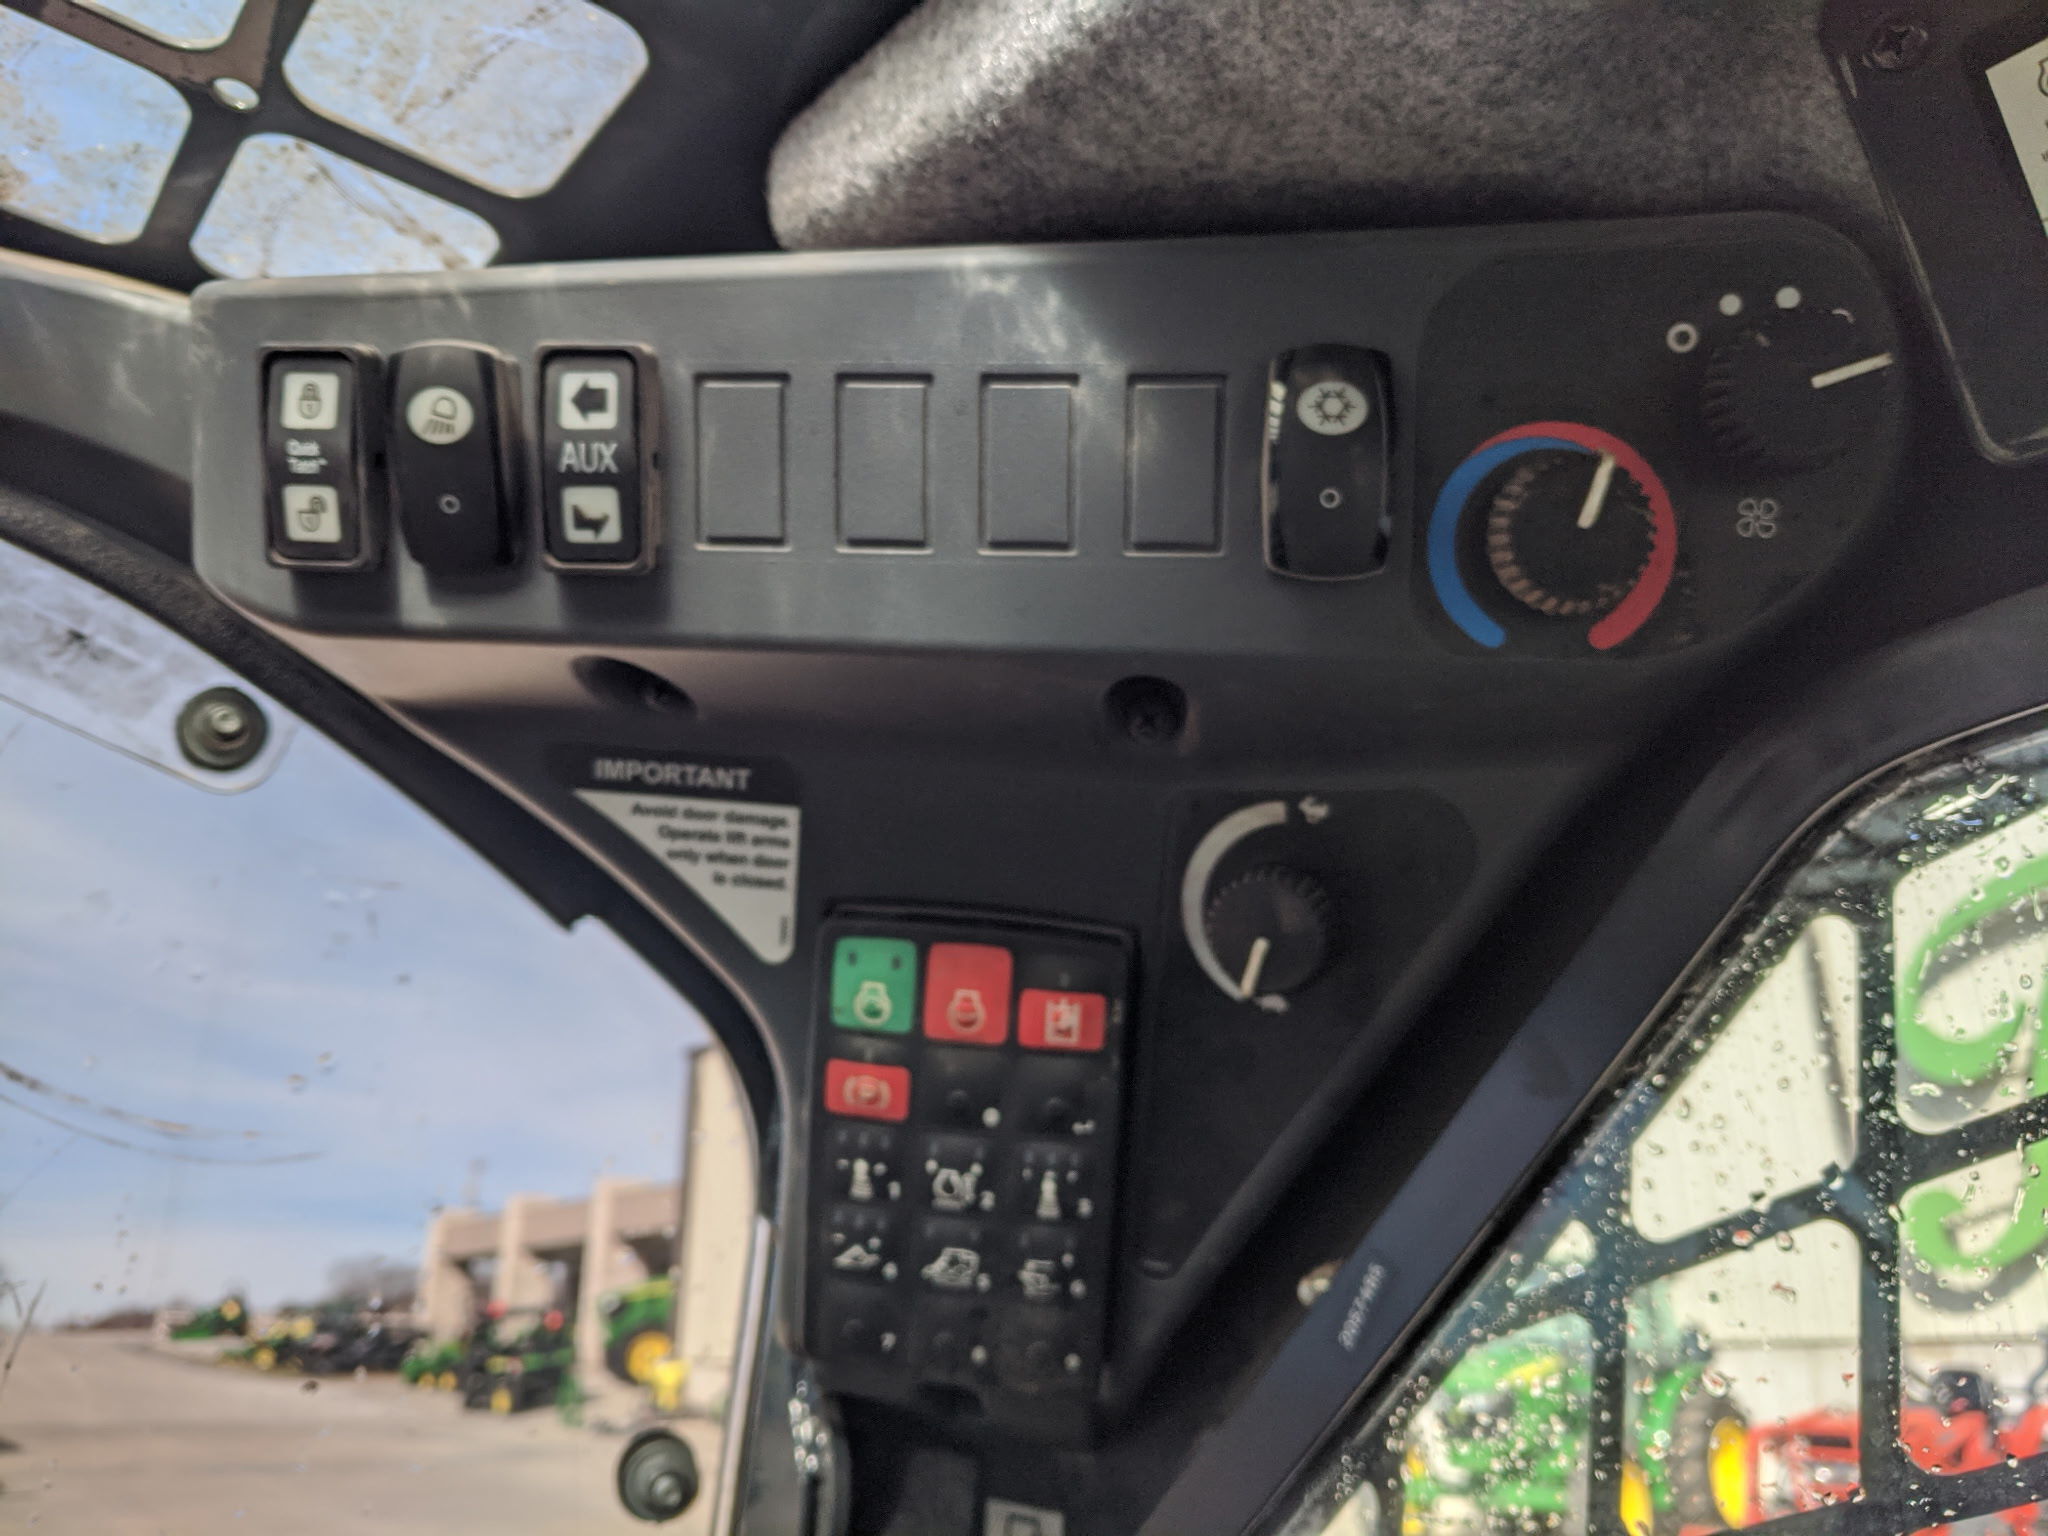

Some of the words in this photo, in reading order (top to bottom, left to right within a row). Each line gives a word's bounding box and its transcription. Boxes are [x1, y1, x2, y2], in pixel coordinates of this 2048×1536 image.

[559, 441, 619, 474] AUX
[594, 759, 752, 792] IMPORTANT
[632, 803, 678, 819] Avoid
[683, 807, 719, 822] door
[658, 824, 721, 844] Operate
[752, 834, 790, 849] arms
[667, 848, 701, 867] only
[705, 850, 748, 866] when
[754, 853, 789, 869] door
